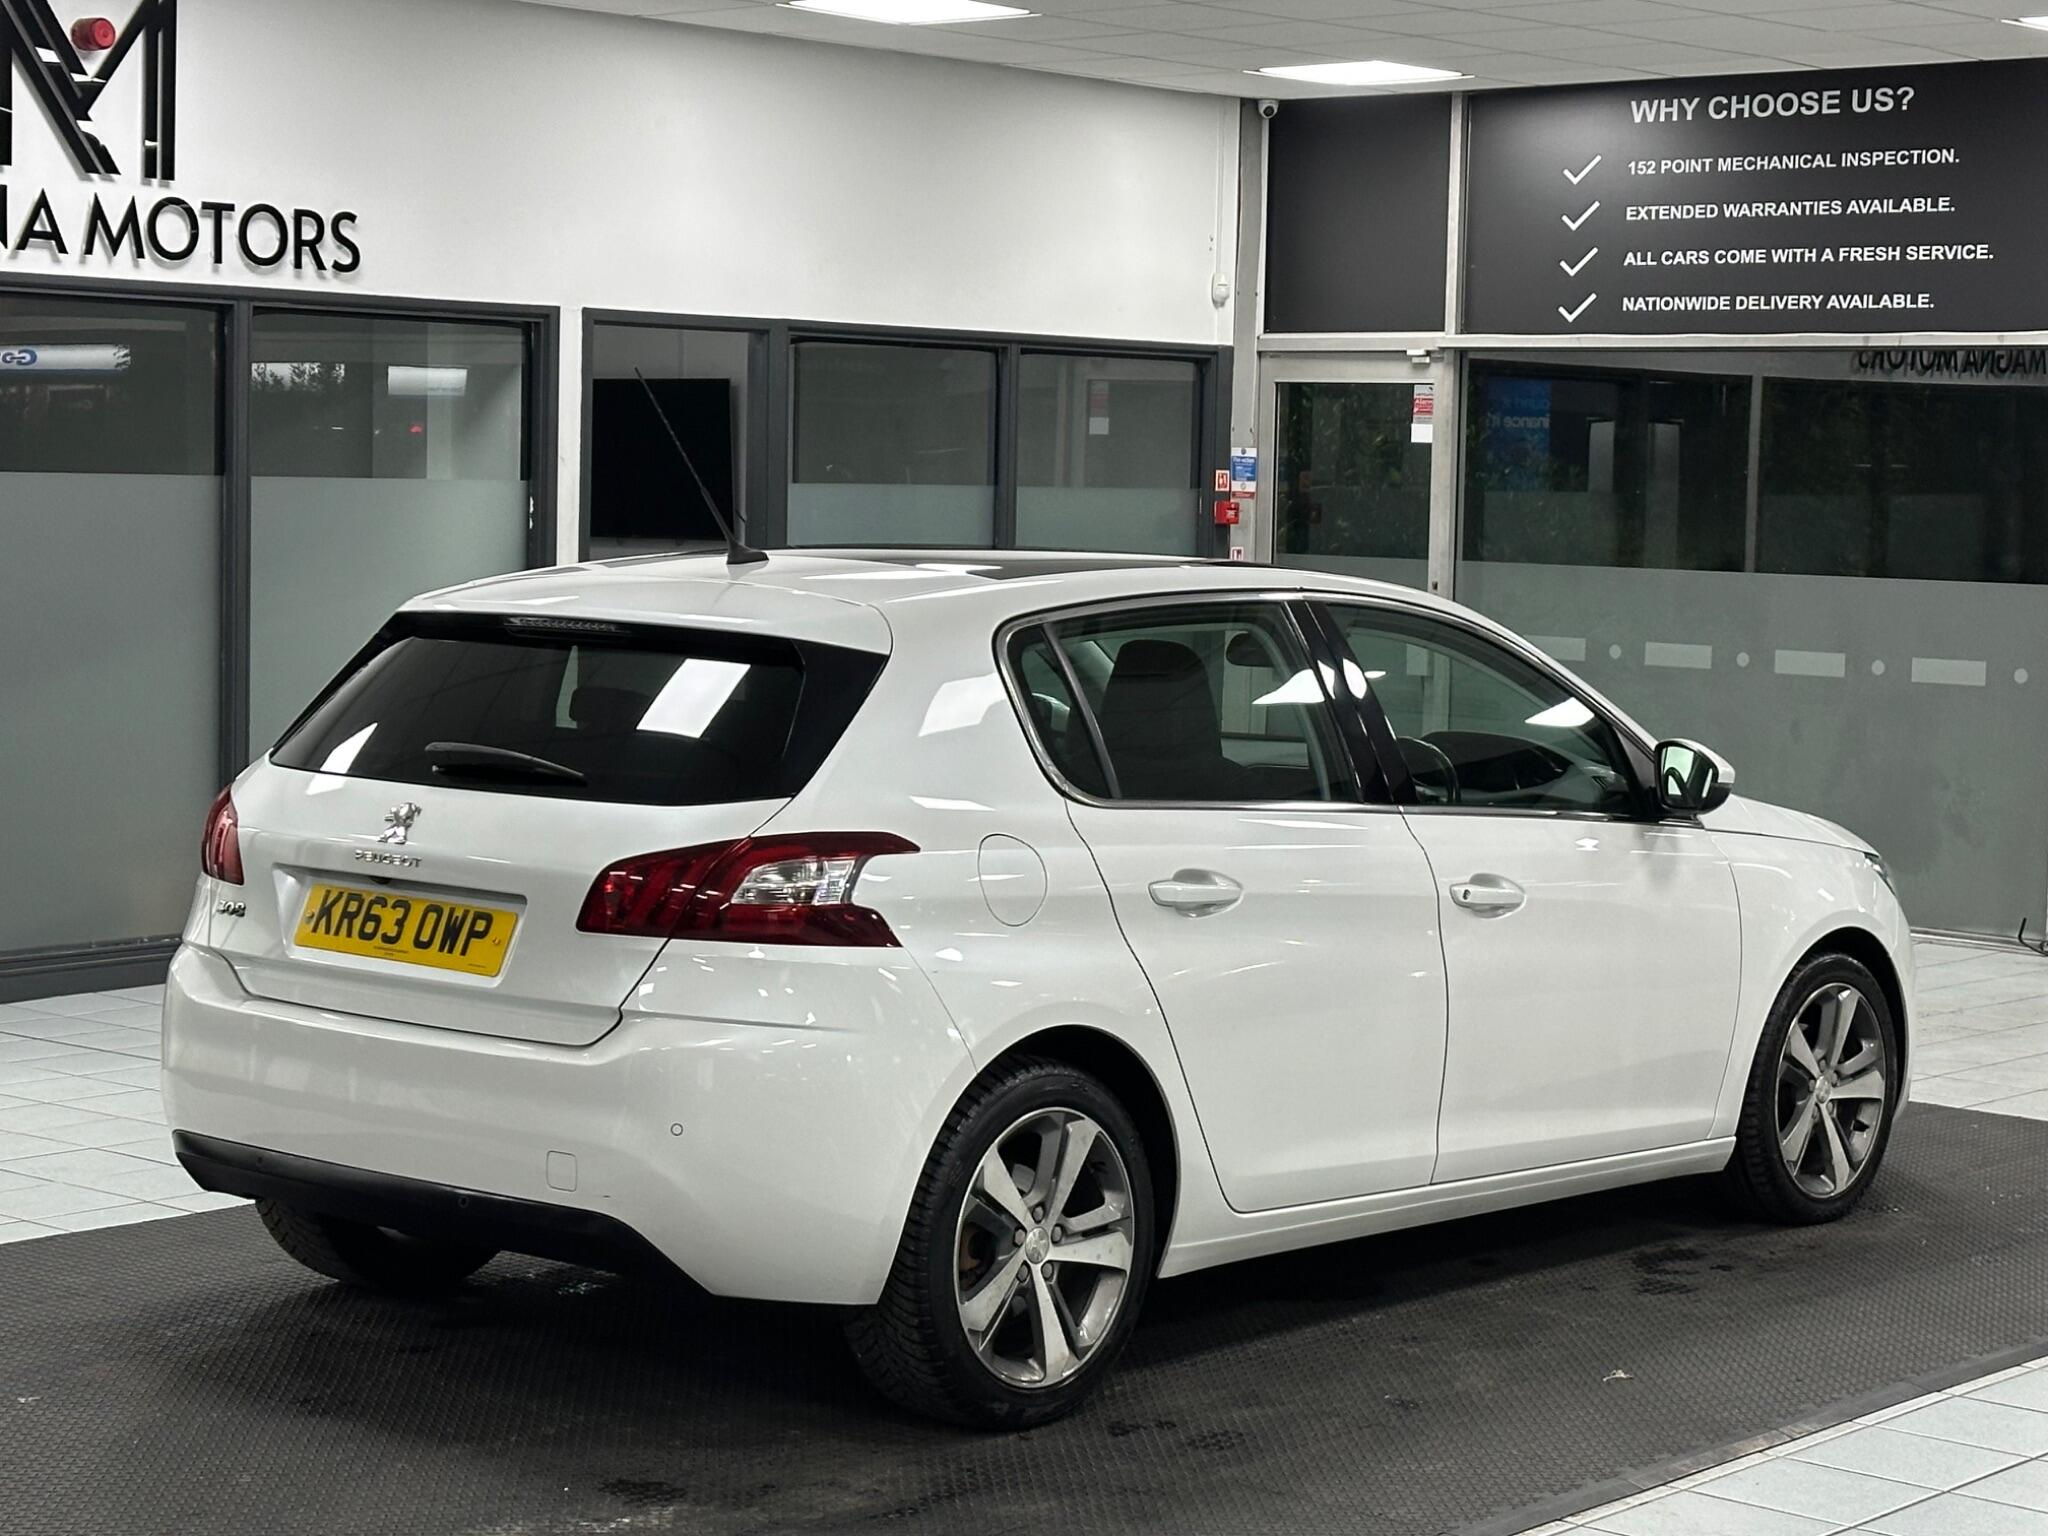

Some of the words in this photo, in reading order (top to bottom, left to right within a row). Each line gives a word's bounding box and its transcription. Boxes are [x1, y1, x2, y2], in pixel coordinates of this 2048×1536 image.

[1630, 97, 1700, 124] WHY
[1706, 90, 1841, 120] CHOOSE
[1851, 86, 1915, 113] US?
[1628, 160, 1656, 176] 152
[1660, 158, 1714, 174] POINT
[1717, 153, 1837, 173] MECHANICAL
[1841, 147, 1960, 168] INSPECTION.
[1625, 204, 1719, 221] EXTENDED
[1723, 200, 1842, 218] WARRANTIES
[1846, 196, 1956, 215] AVAILABLE.
[0, 184, 69, 255] A
[84, 192, 361, 273] MOTORS
[1623, 250, 1658, 267] ALL
[1660, 250, 1710, 266] CARS
[1713, 249, 1767, 265] COME
[1770, 247, 1817, 264] WITH
[1820, 247, 1835, 263] A
[1838, 246, 1901, 263] FRESH
[1905, 244, 1994, 261] SERVICE.
[1622, 295, 1731, 312] NATIONWIDE
[1735, 295, 1824, 311] DELIVERY
[1826, 293, 1935, 310] AVAILABLE.
[354, 848, 422, 868] PEUGEOT
[311, 888, 411, 946] KR63
[413, 903, 493, 957] OWP
